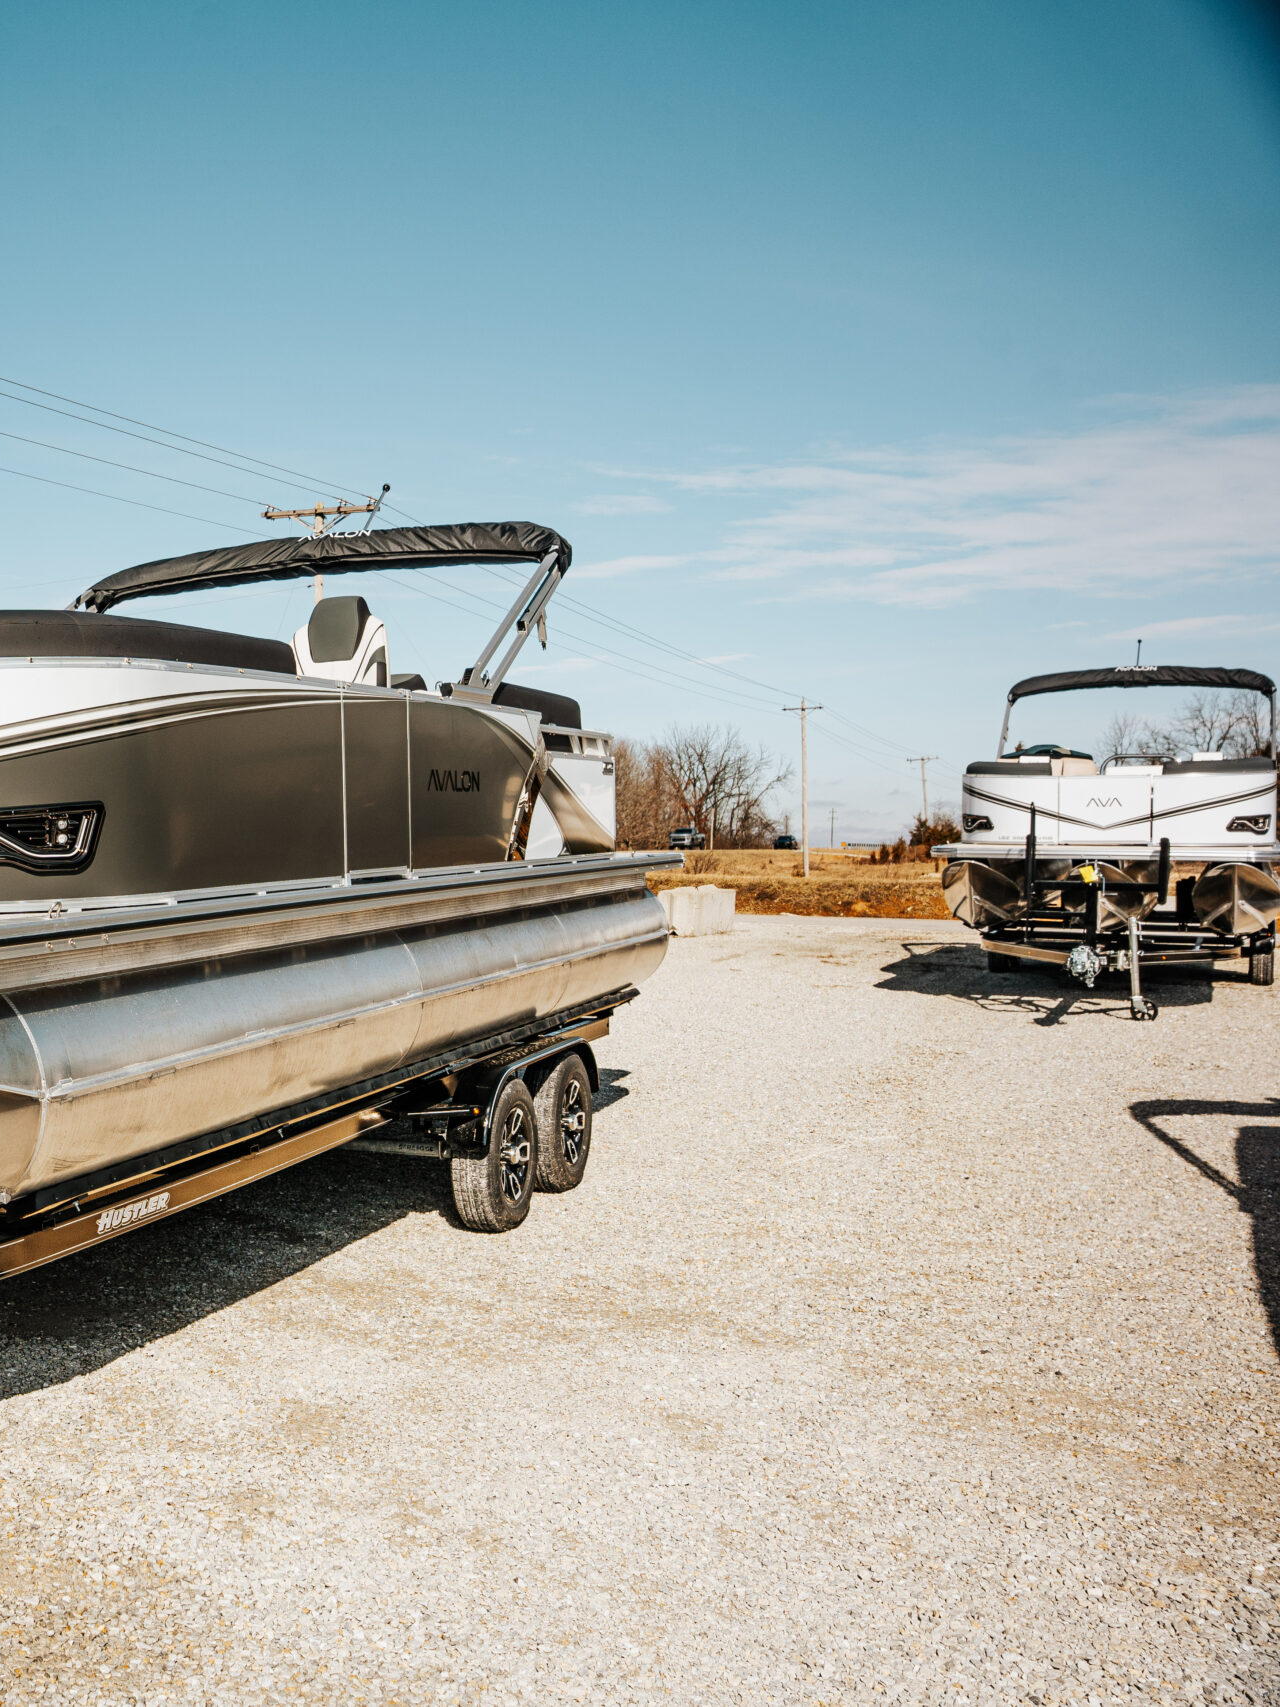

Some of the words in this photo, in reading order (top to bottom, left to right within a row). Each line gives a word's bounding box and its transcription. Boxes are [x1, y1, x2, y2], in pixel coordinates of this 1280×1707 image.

[298, 529, 373, 542] AVALON
[427, 768, 481, 793] AVALON
[1086, 797, 1123, 808] AVA
[96, 1191, 171, 1235] HUSTLER
